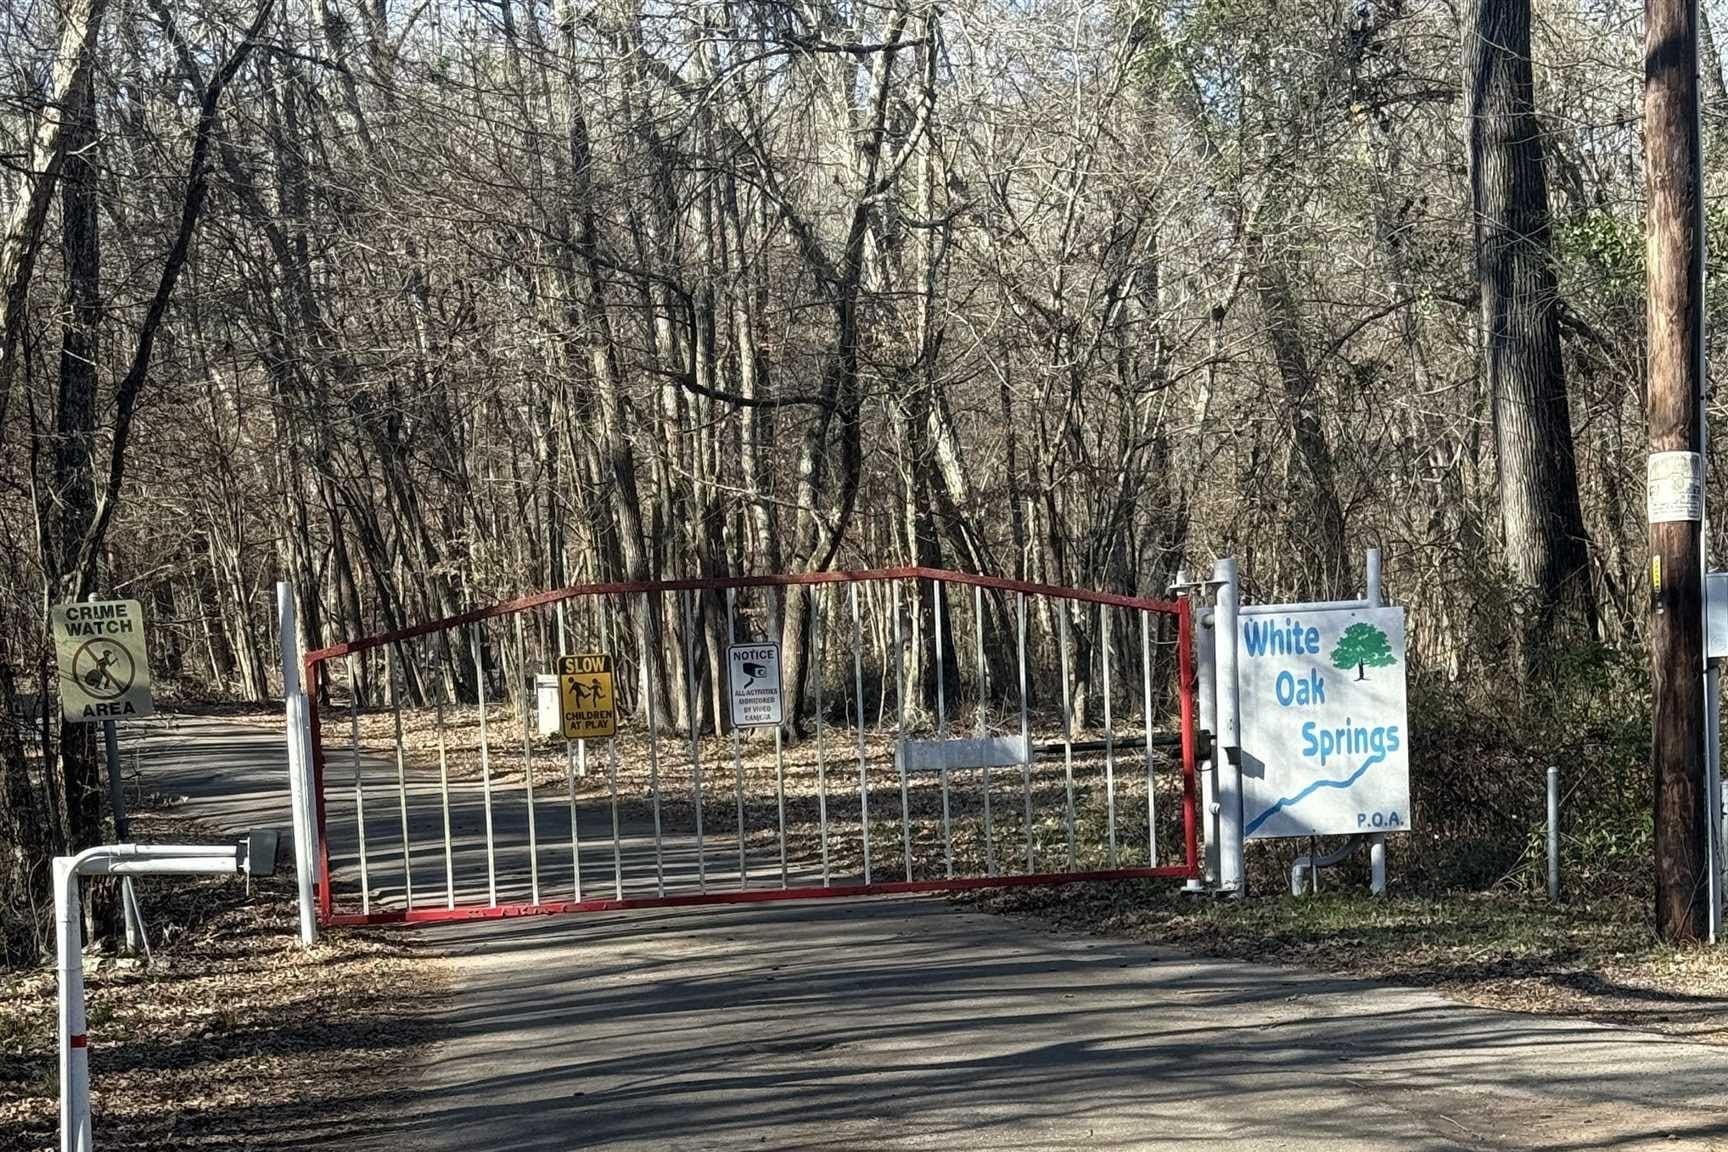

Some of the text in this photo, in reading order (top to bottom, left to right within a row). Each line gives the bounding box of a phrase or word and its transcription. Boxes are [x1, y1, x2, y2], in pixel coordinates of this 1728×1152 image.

[65, 604, 128, 621] CRIME
[65, 619, 133, 637] WATCH
[1244, 617, 1320, 657] White
[733, 650, 775, 661] NOTICE
[565, 656, 605, 673] SLOW
[1275, 667, 1326, 707] Oak
[83, 701, 136, 717] AREA
[565, 710, 612, 721] CHILDREN
[570, 720, 608, 730] AT PLAY
[1301, 717, 1400, 767] Springs
[1357, 812, 1404, 828] P.O.A.
